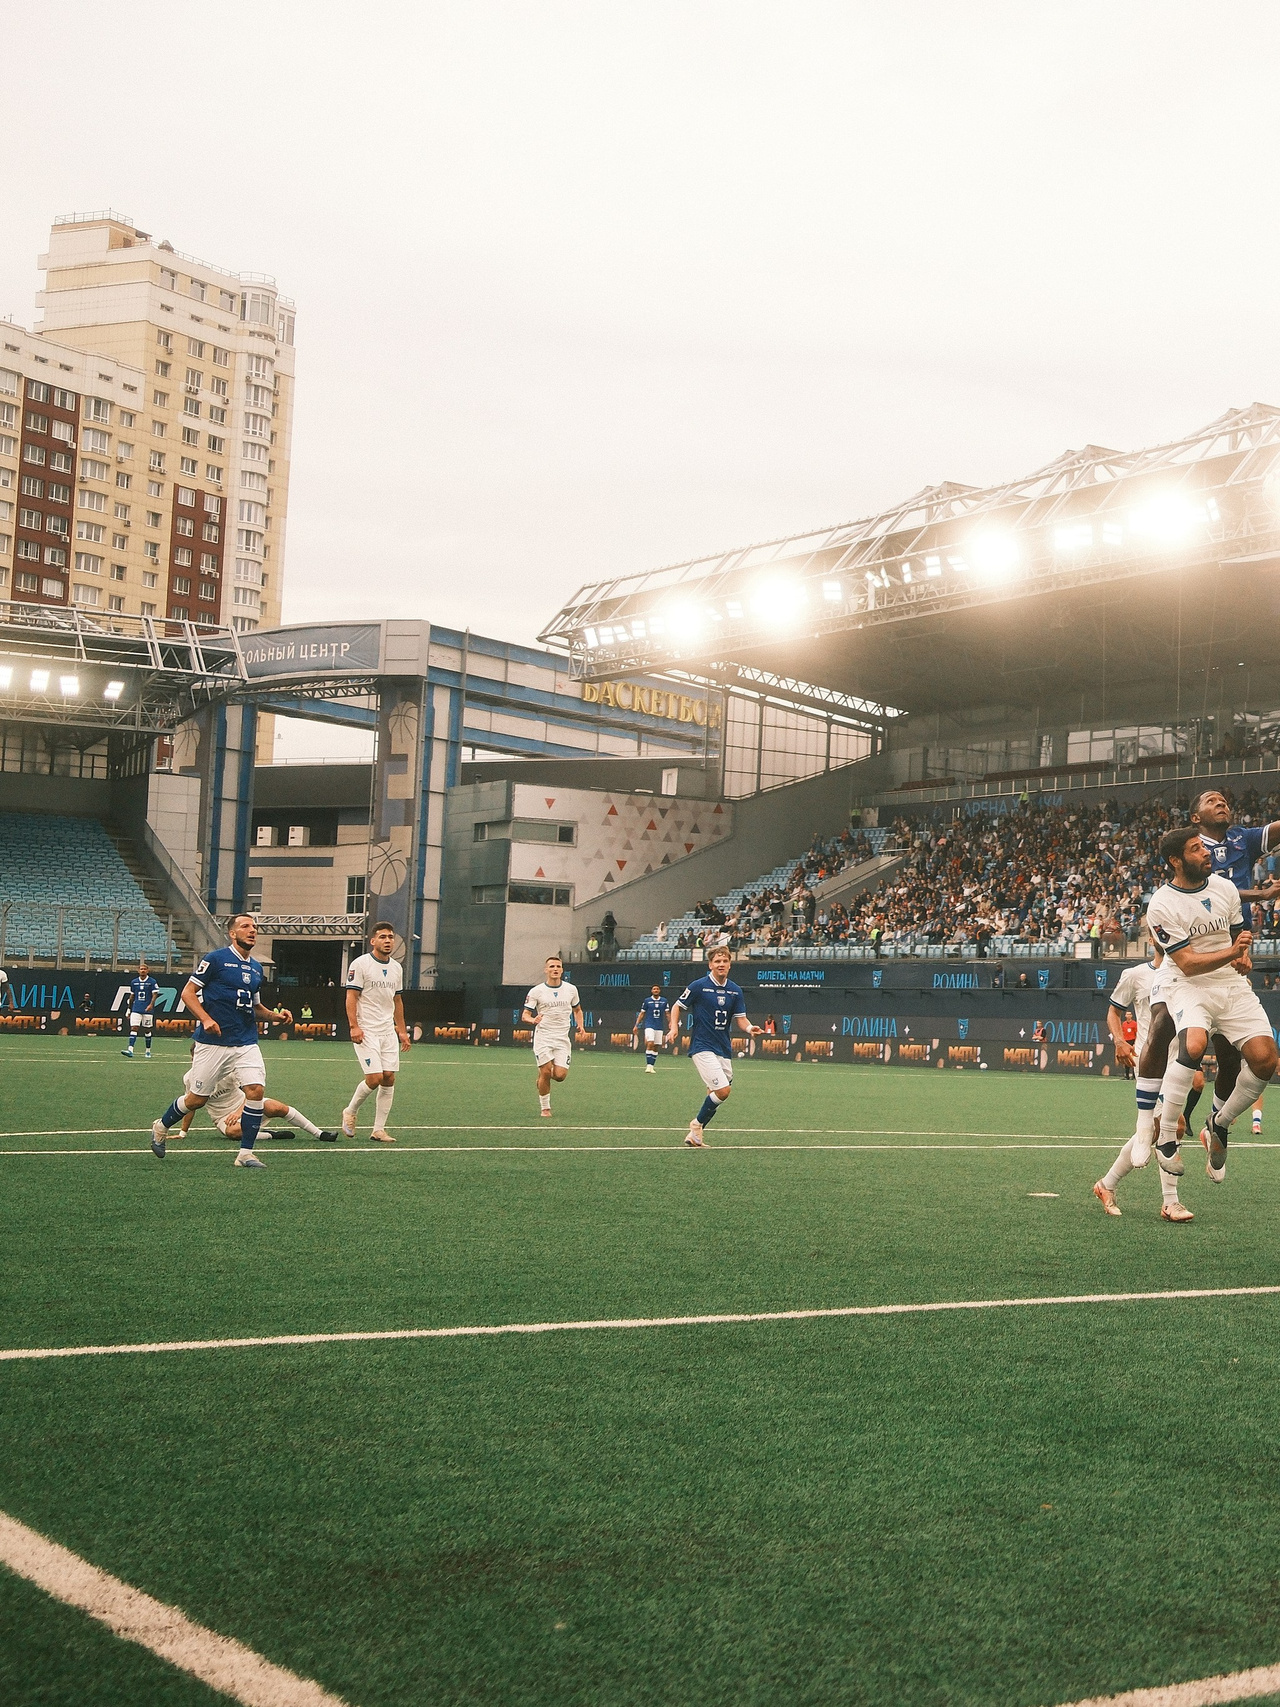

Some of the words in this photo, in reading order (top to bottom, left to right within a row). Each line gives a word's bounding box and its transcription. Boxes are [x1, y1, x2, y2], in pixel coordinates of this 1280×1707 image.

[300, 642, 350, 660] ЦЕНТР
[757, 970, 787, 981] БИЛЕТЫ
[788, 970, 798, 981] НА
[799, 970, 825, 981] МАТЧИ
[75, 1017, 123, 1032] МАТЧ!
[948, 1045, 981, 1063] МАТЧ!
[1003, 1047, 1039, 1066] МАТЧ!
[1057, 1050, 1093, 1068] МАТЧ!
